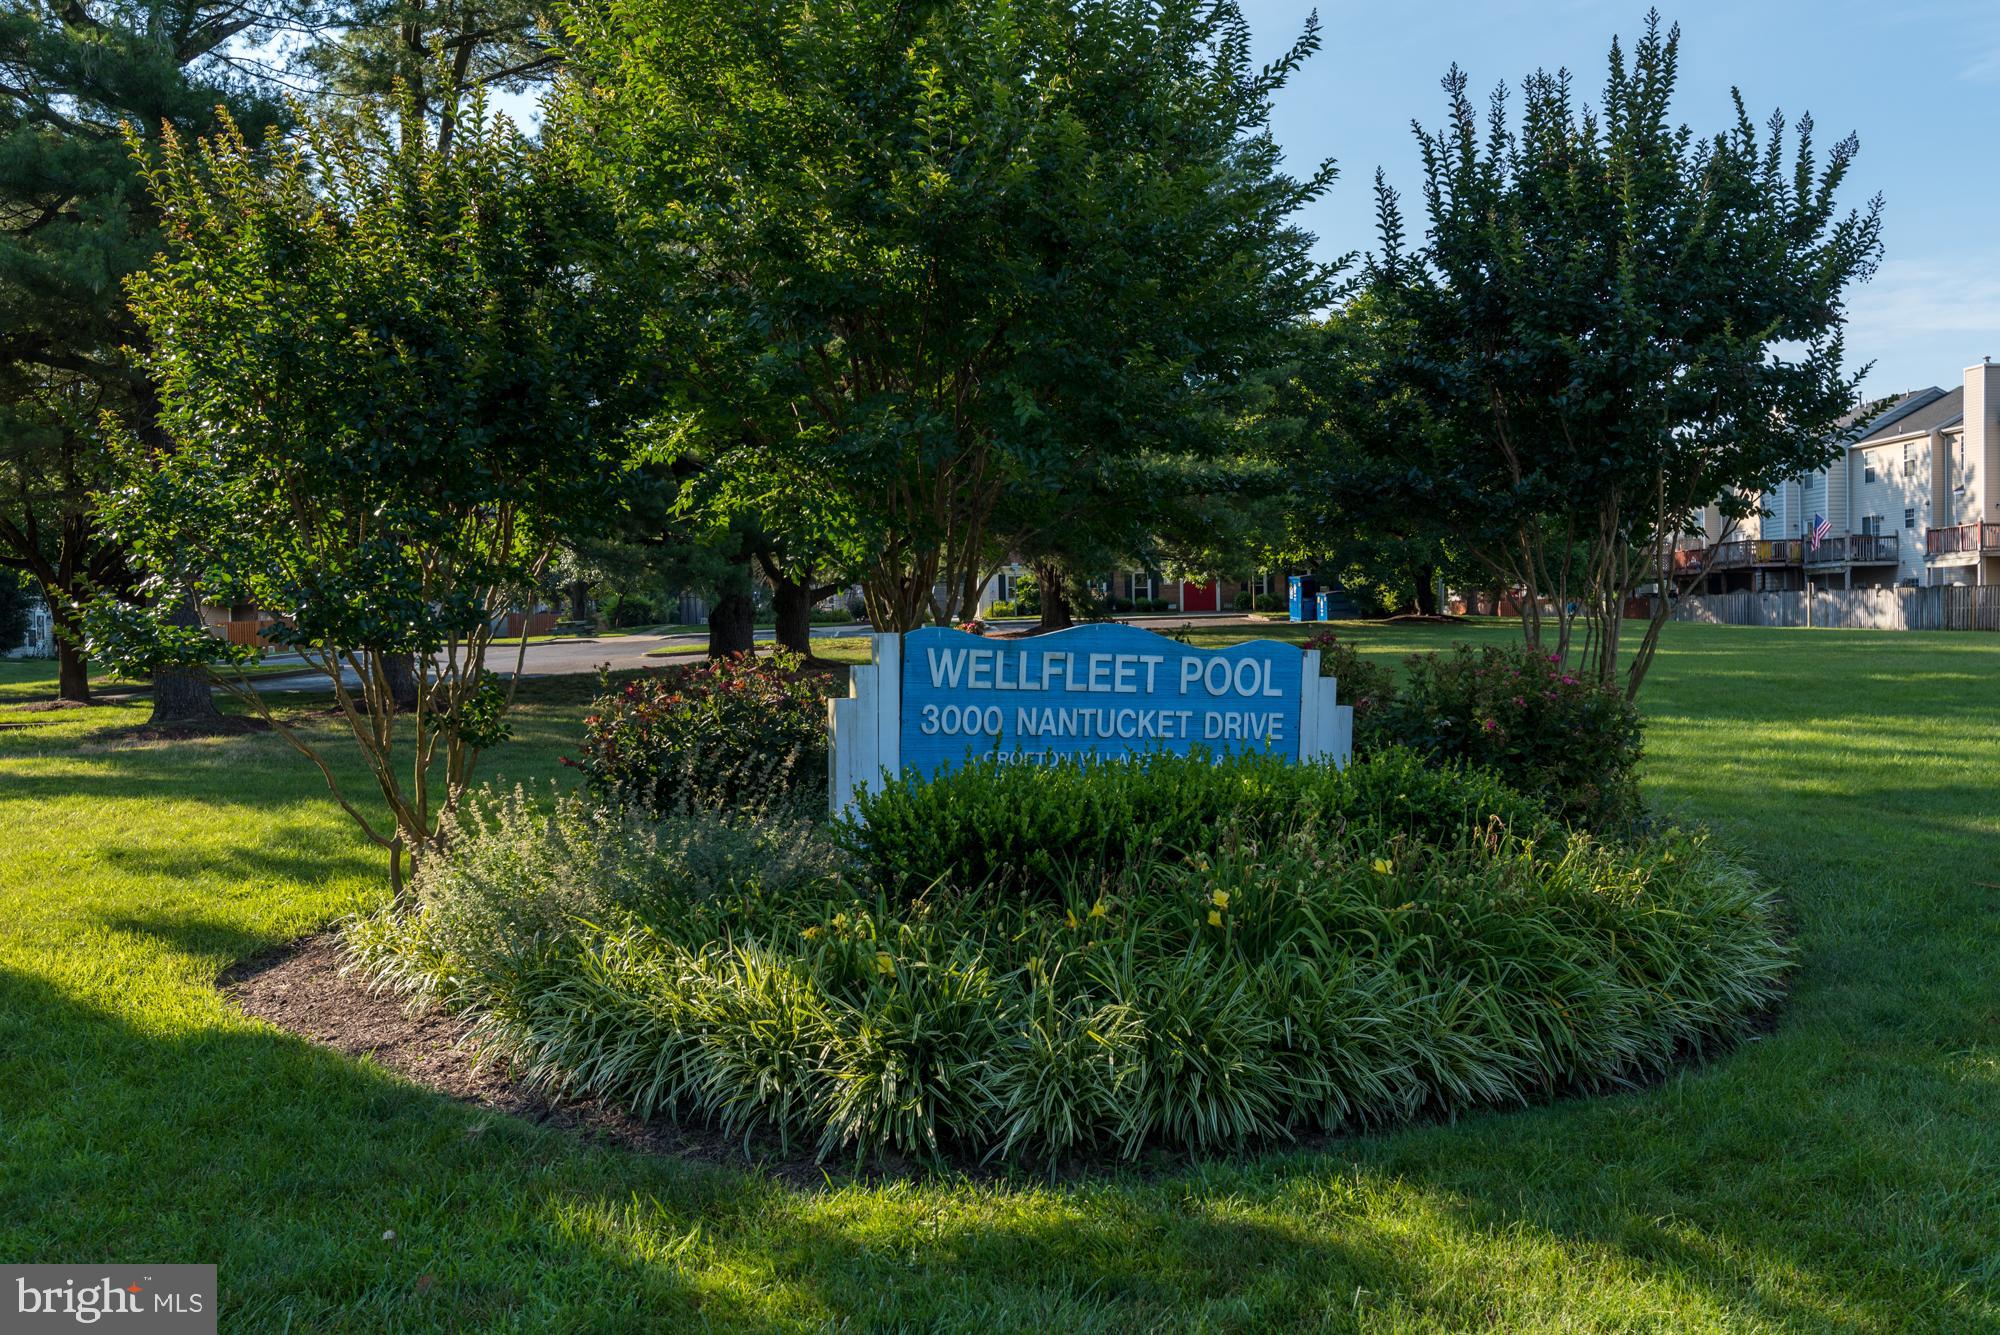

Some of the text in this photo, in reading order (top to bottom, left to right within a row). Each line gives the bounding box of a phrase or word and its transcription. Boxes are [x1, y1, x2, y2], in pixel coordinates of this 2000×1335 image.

[926, 647, 1284, 698] WELLFLEET POOL
[920, 703, 1284, 741] 3000 NANTUCKET DRIVE
